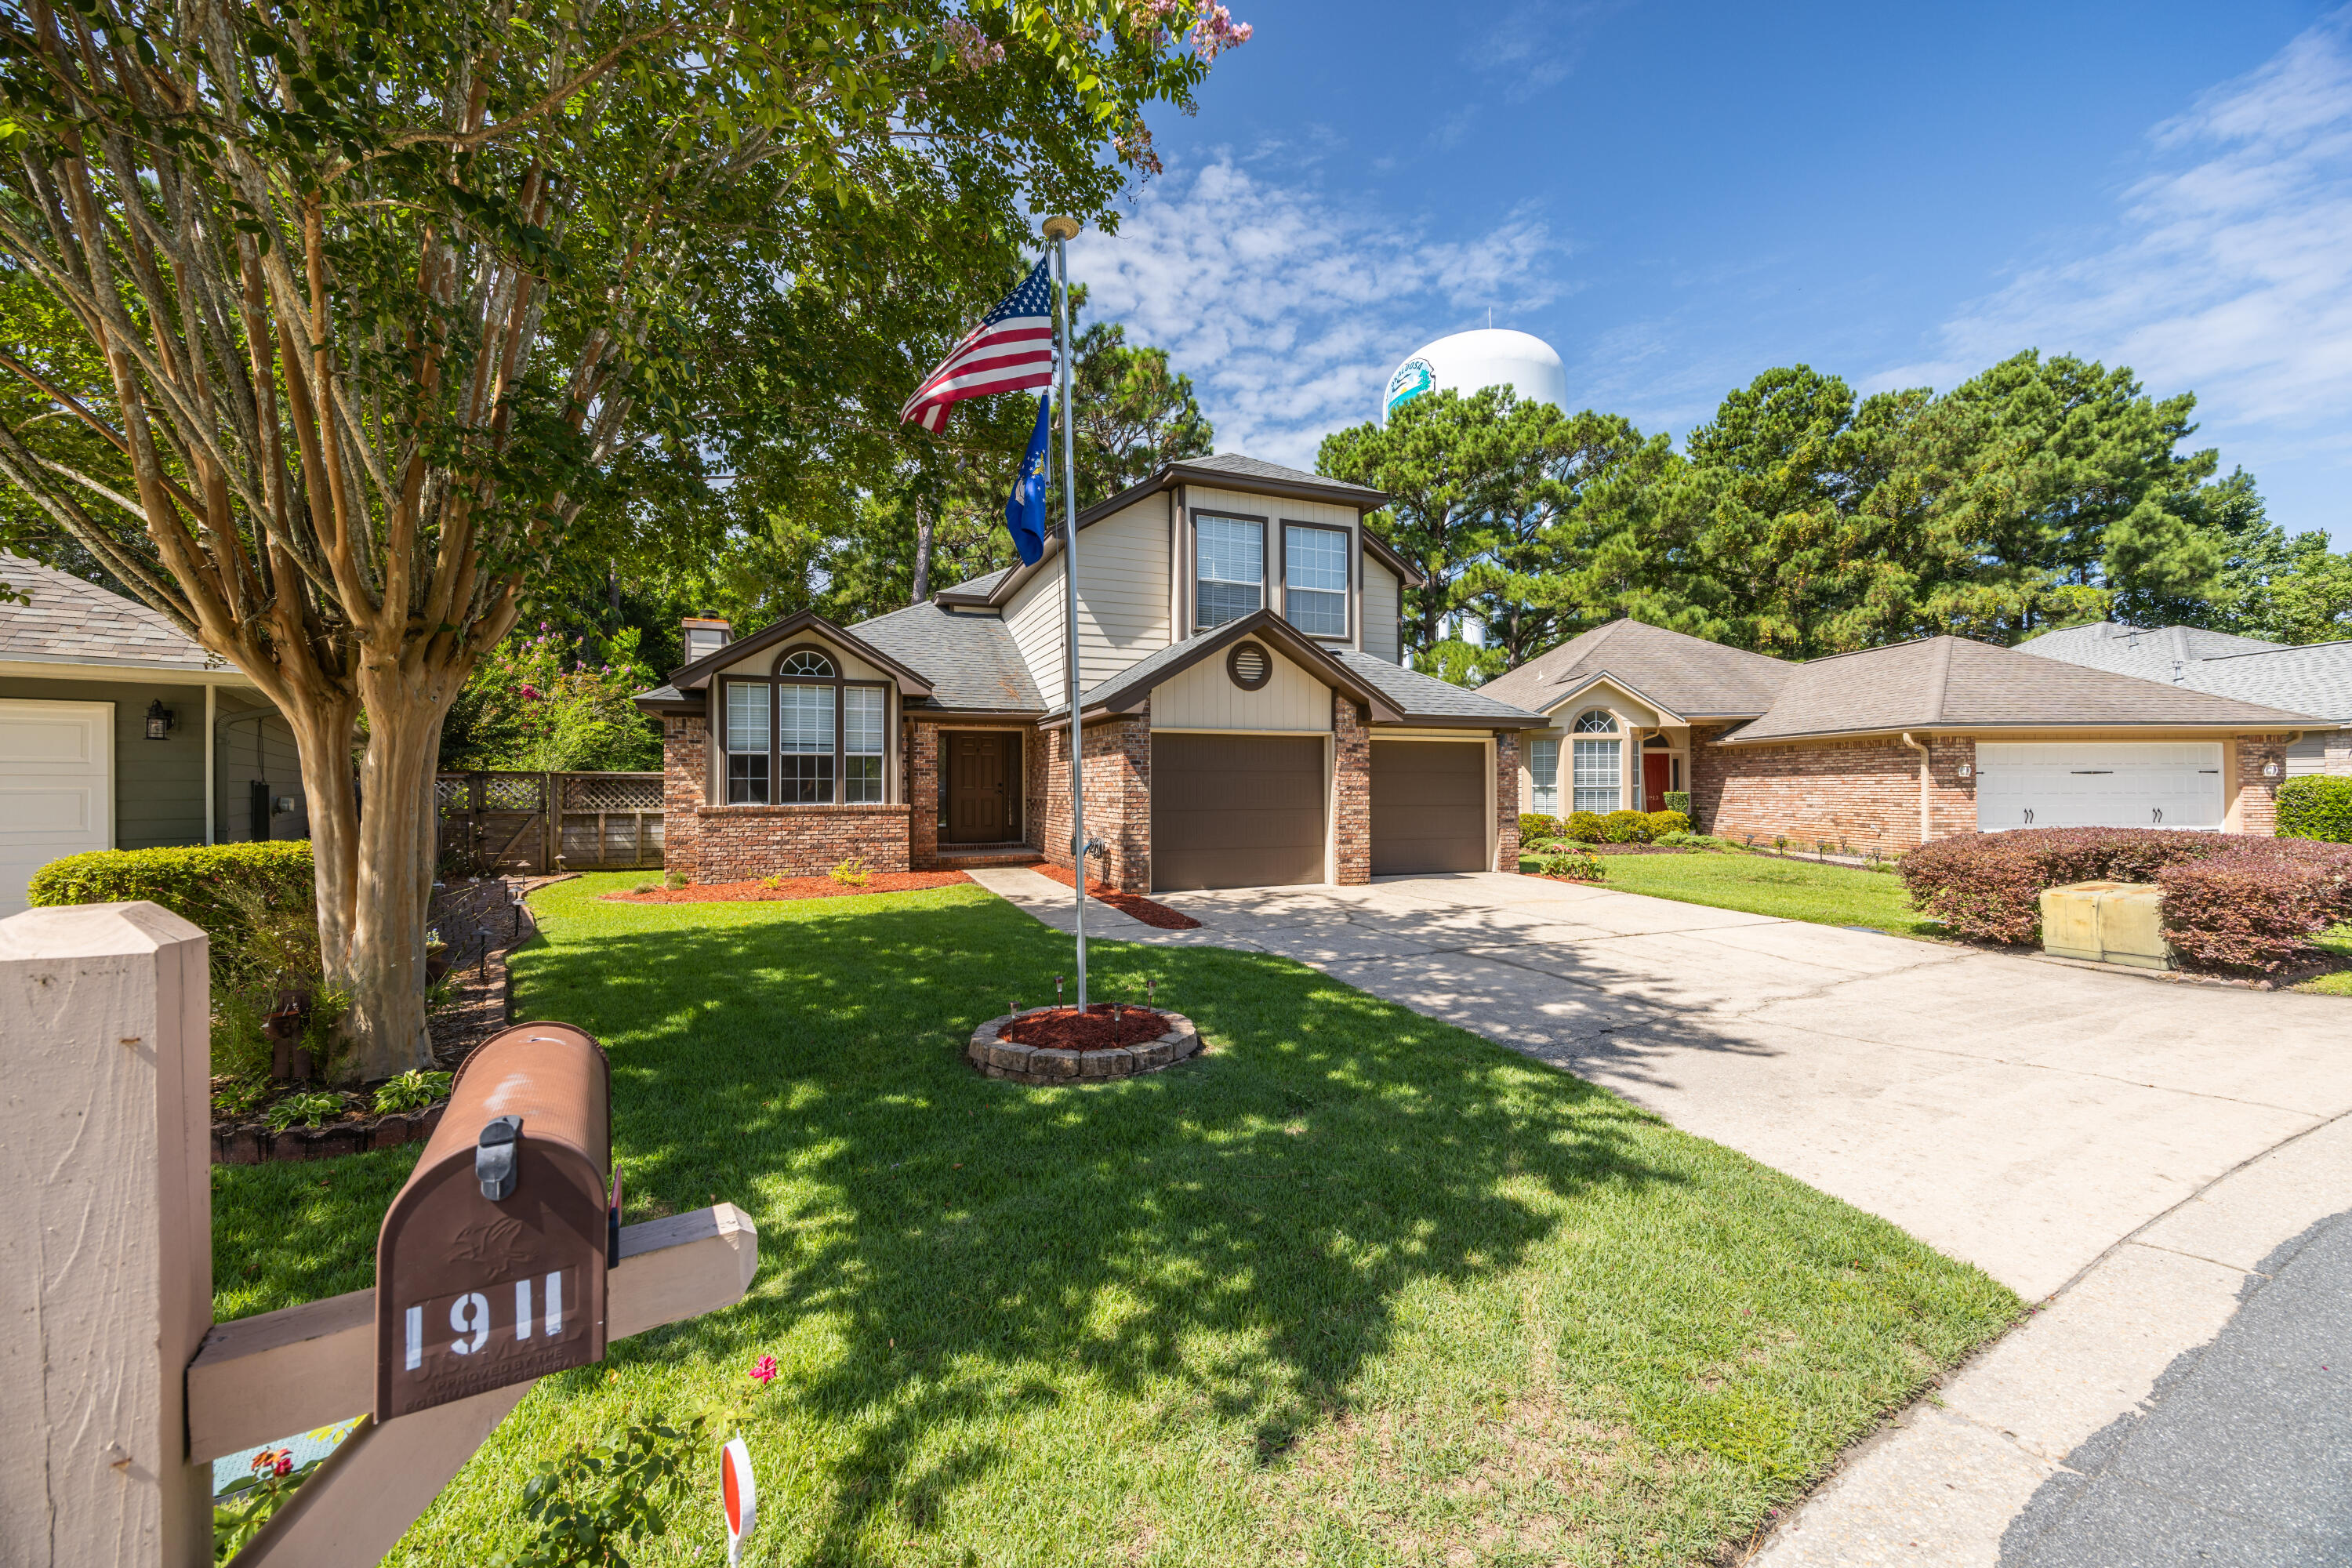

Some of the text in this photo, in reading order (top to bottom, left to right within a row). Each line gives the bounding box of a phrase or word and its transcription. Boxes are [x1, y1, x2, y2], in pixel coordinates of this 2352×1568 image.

[1391, 361, 1424, 387] OKALOOSA
[405, 1271, 562, 1371] 1911
[404, 1356, 581, 1413] POSTMASTER GENERAL
[425, 1347, 564, 1392] APPROVED BY THE
